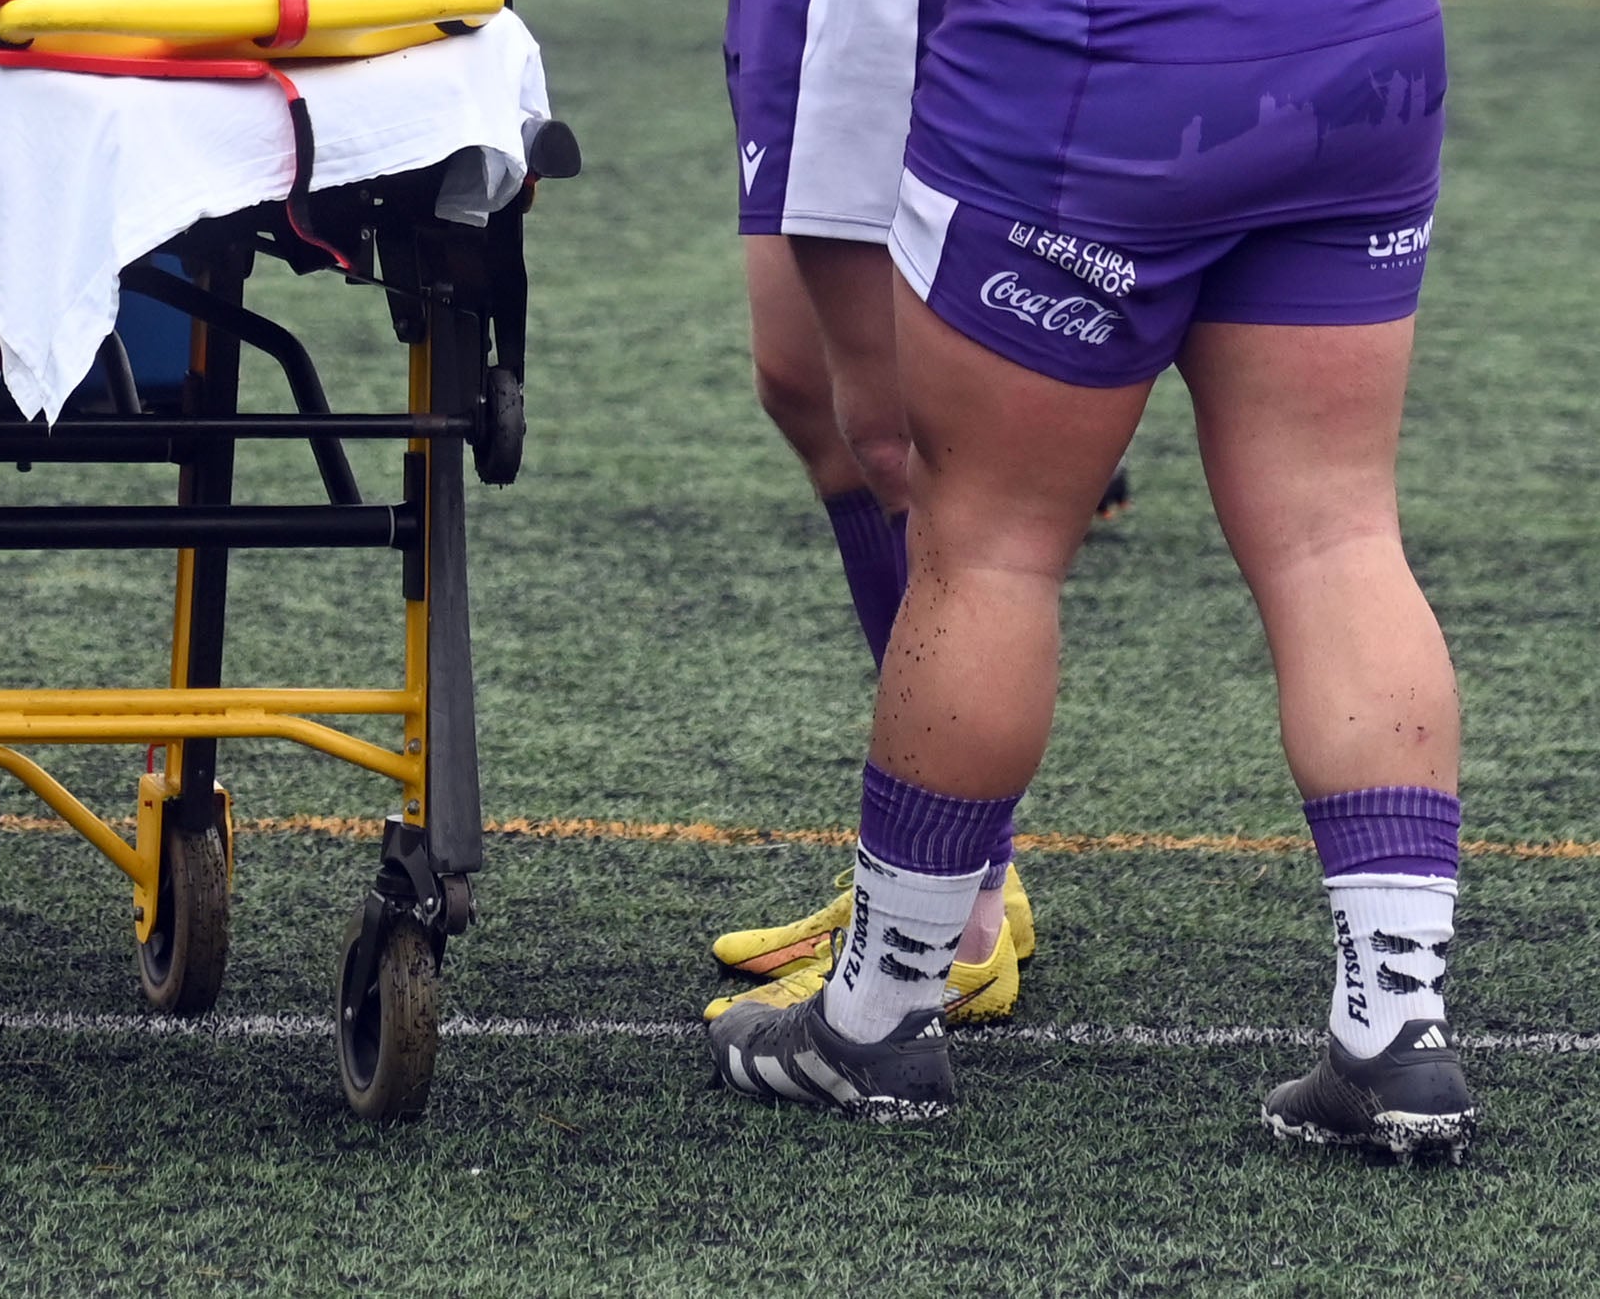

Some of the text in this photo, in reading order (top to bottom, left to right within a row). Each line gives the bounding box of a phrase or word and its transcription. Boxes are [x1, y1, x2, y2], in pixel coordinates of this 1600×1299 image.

[1032, 235, 1136, 298] SEGUROS
[1082, 242, 1136, 279] CURA
[1368, 214, 1434, 257] UEM
[979, 271, 1126, 345] Coca-Cola
[842, 884, 871, 993] FLYSOCKS
[1334, 909, 1371, 1029] FLYSOCKS
